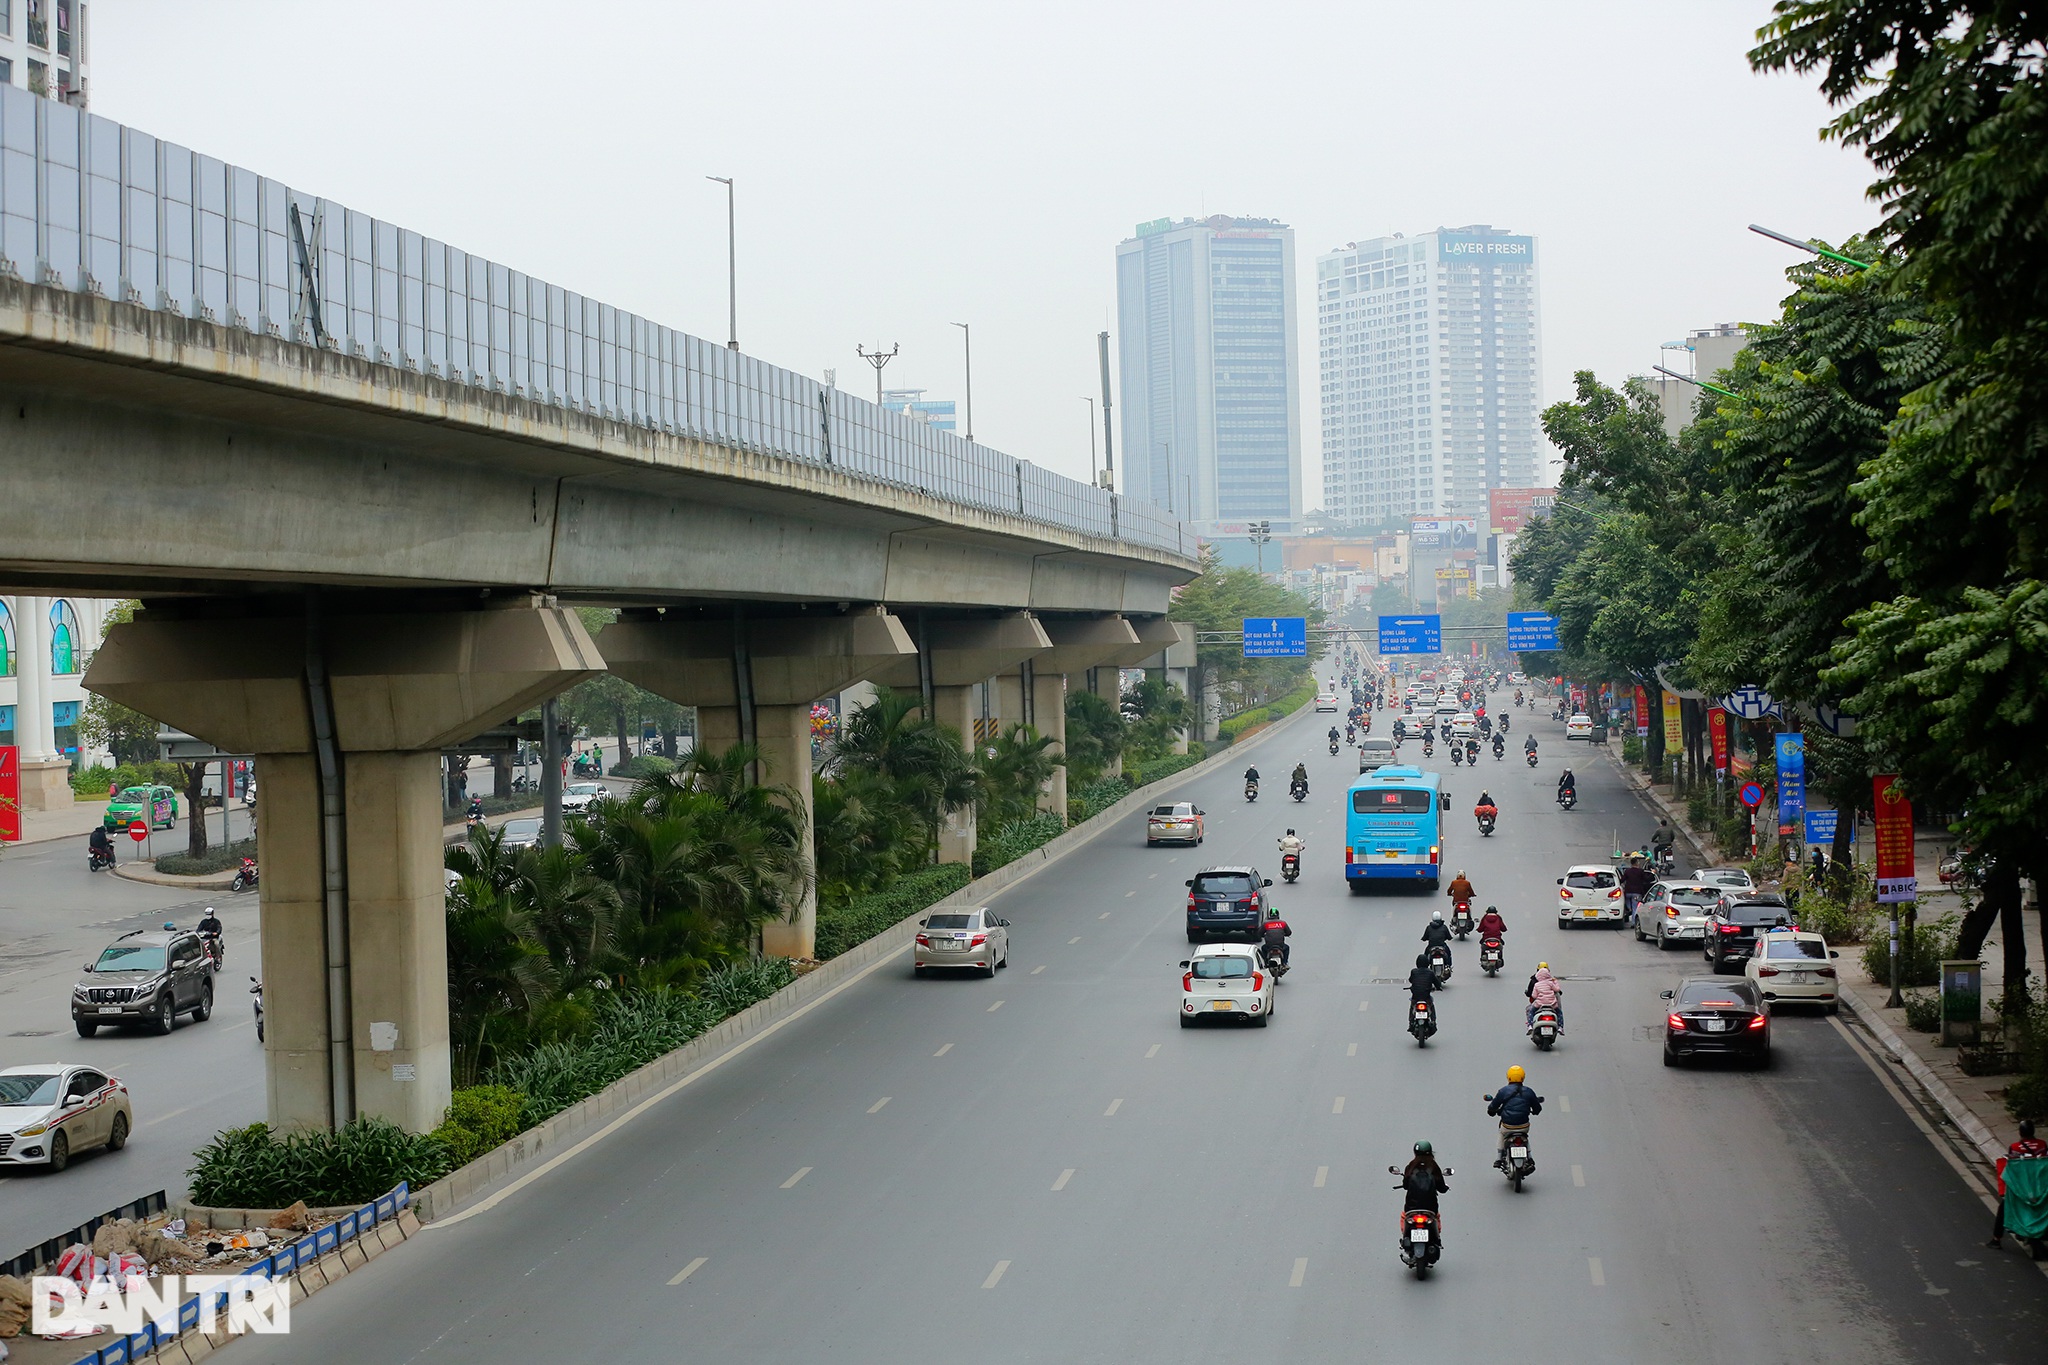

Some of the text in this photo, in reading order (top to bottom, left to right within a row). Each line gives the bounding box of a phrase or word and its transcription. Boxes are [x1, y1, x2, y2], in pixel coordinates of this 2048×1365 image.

[1445, 243, 1526, 255] LAYER FRESH
[1890, 884, 1913, 892] ABIC
